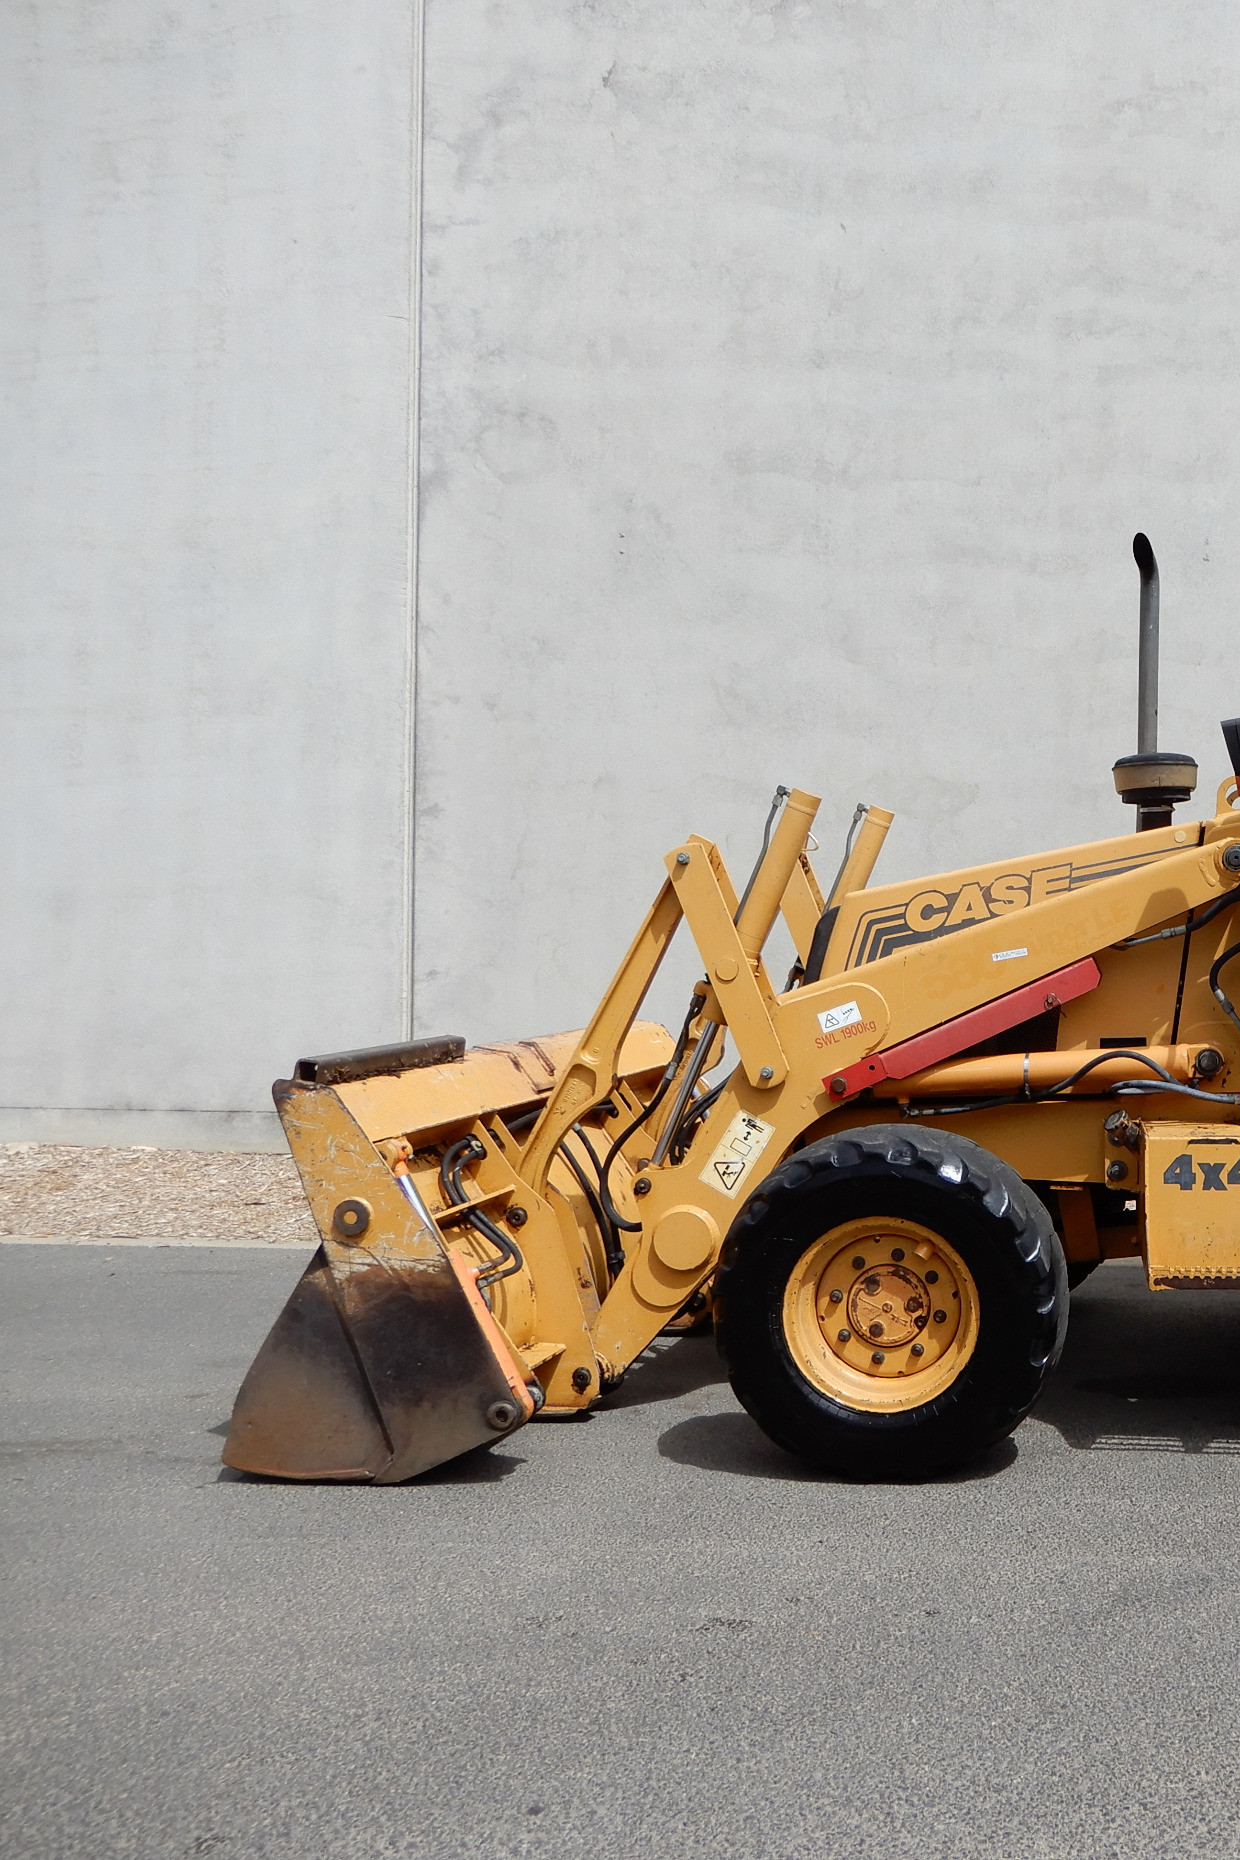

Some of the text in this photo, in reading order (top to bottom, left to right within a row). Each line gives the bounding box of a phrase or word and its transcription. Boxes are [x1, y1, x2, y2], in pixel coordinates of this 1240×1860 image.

[905, 863, 1072, 930] CASE
[814, 1020, 877, 1049] SWL 1900kg
